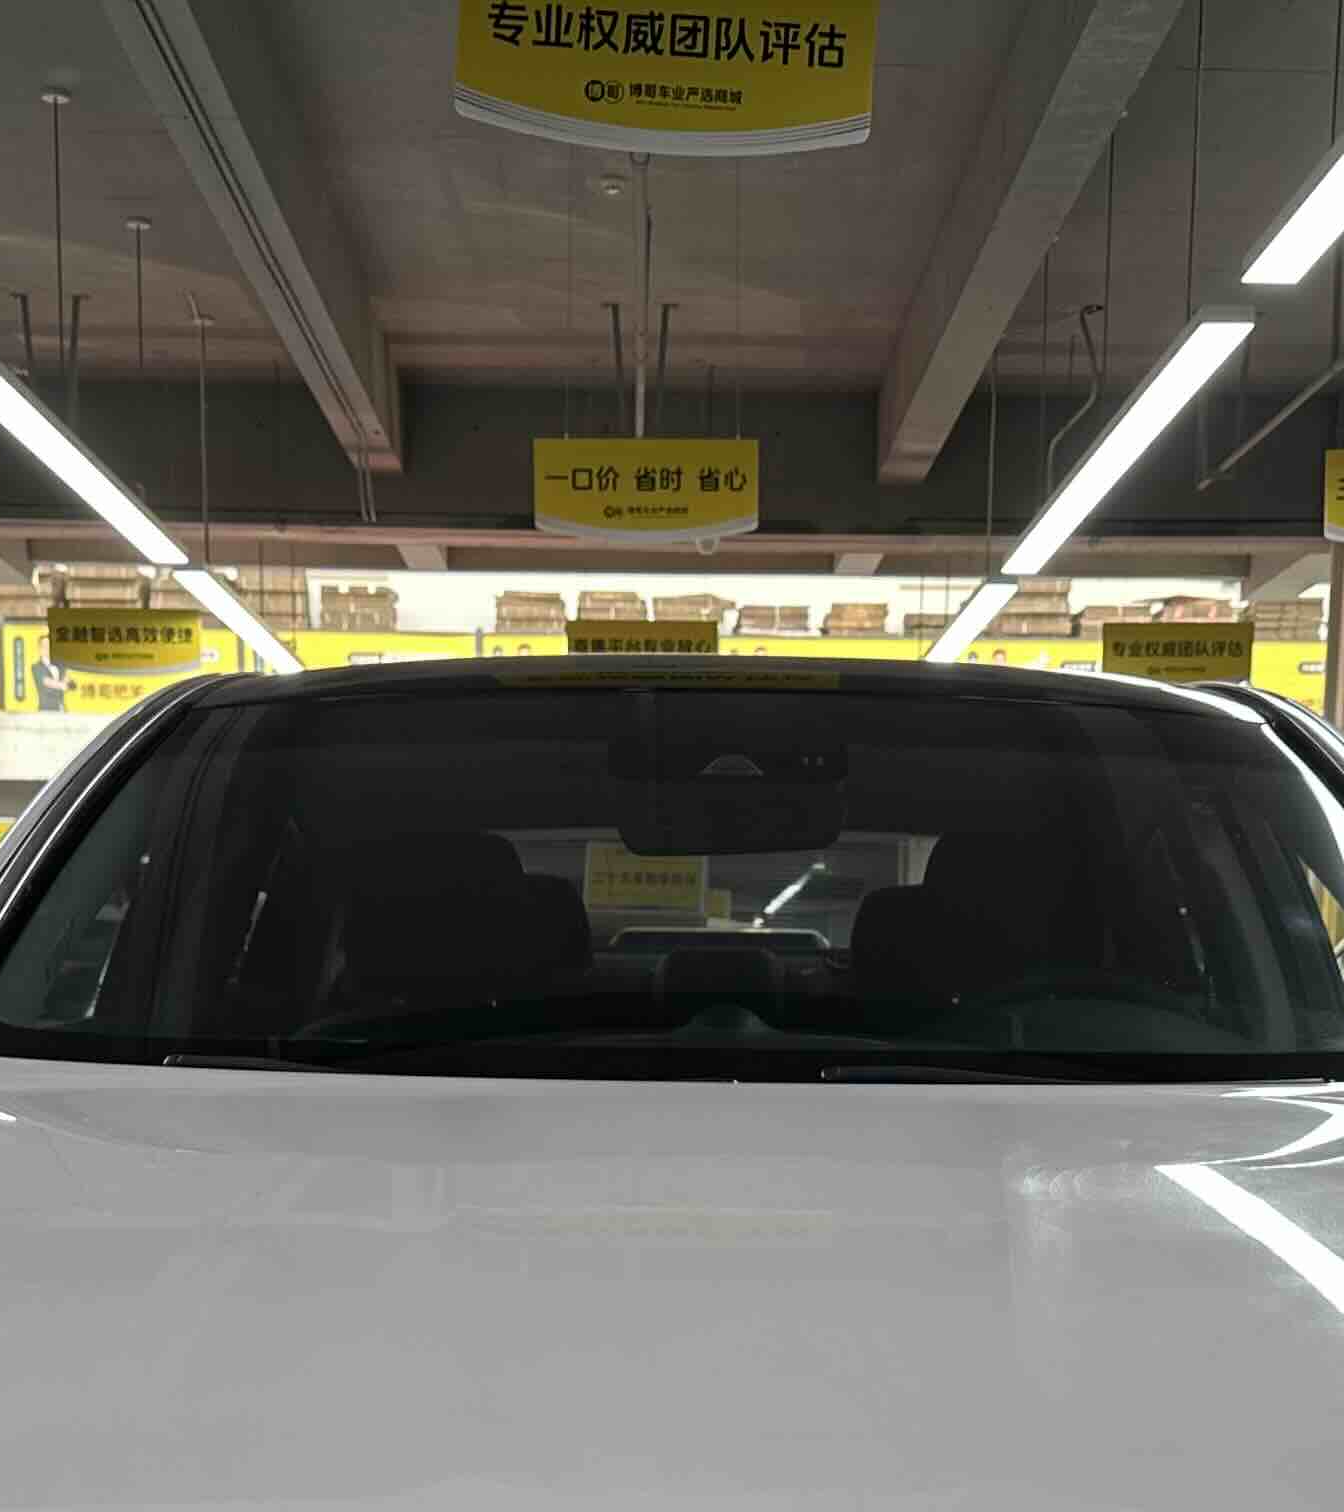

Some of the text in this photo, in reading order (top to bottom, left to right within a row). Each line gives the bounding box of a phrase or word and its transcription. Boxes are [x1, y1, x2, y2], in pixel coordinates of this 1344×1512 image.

[488, 1, 847, 68] 专业权威团队评估
[544, 466, 748, 492] 一口价 省时 省心
